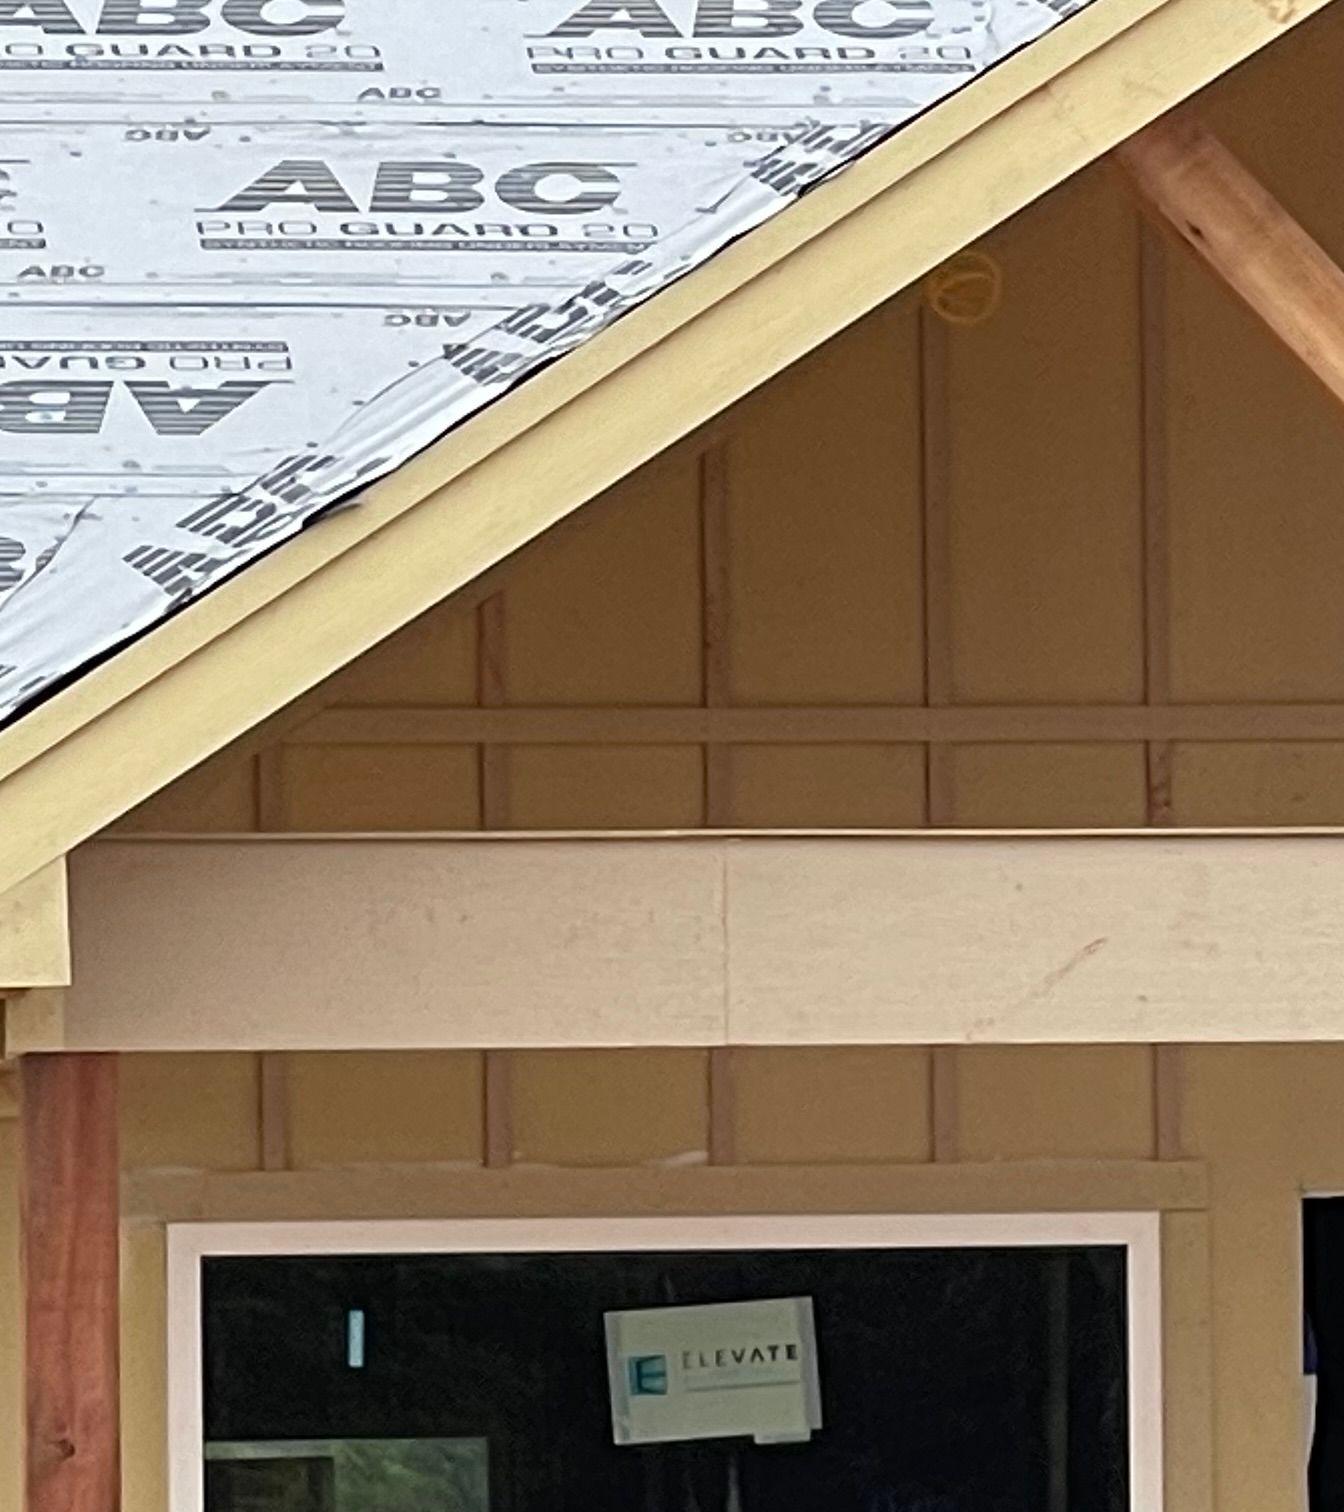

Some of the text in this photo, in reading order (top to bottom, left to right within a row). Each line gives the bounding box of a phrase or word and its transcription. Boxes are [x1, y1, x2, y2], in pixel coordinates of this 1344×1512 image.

[523, 0, 935, 38] ABC
[664, 47, 876, 60] GUARD
[194, 159, 638, 215] ABC
[196, 221, 659, 238] PRO GUARD 20
[17, 264, 106, 278] ABC
[383, 311, 473, 328] ABC
[0, 355, 293, 372] PRO GUA
[0, 379, 294, 434] AB
[682, 1344, 799, 1370] ELEVATE
